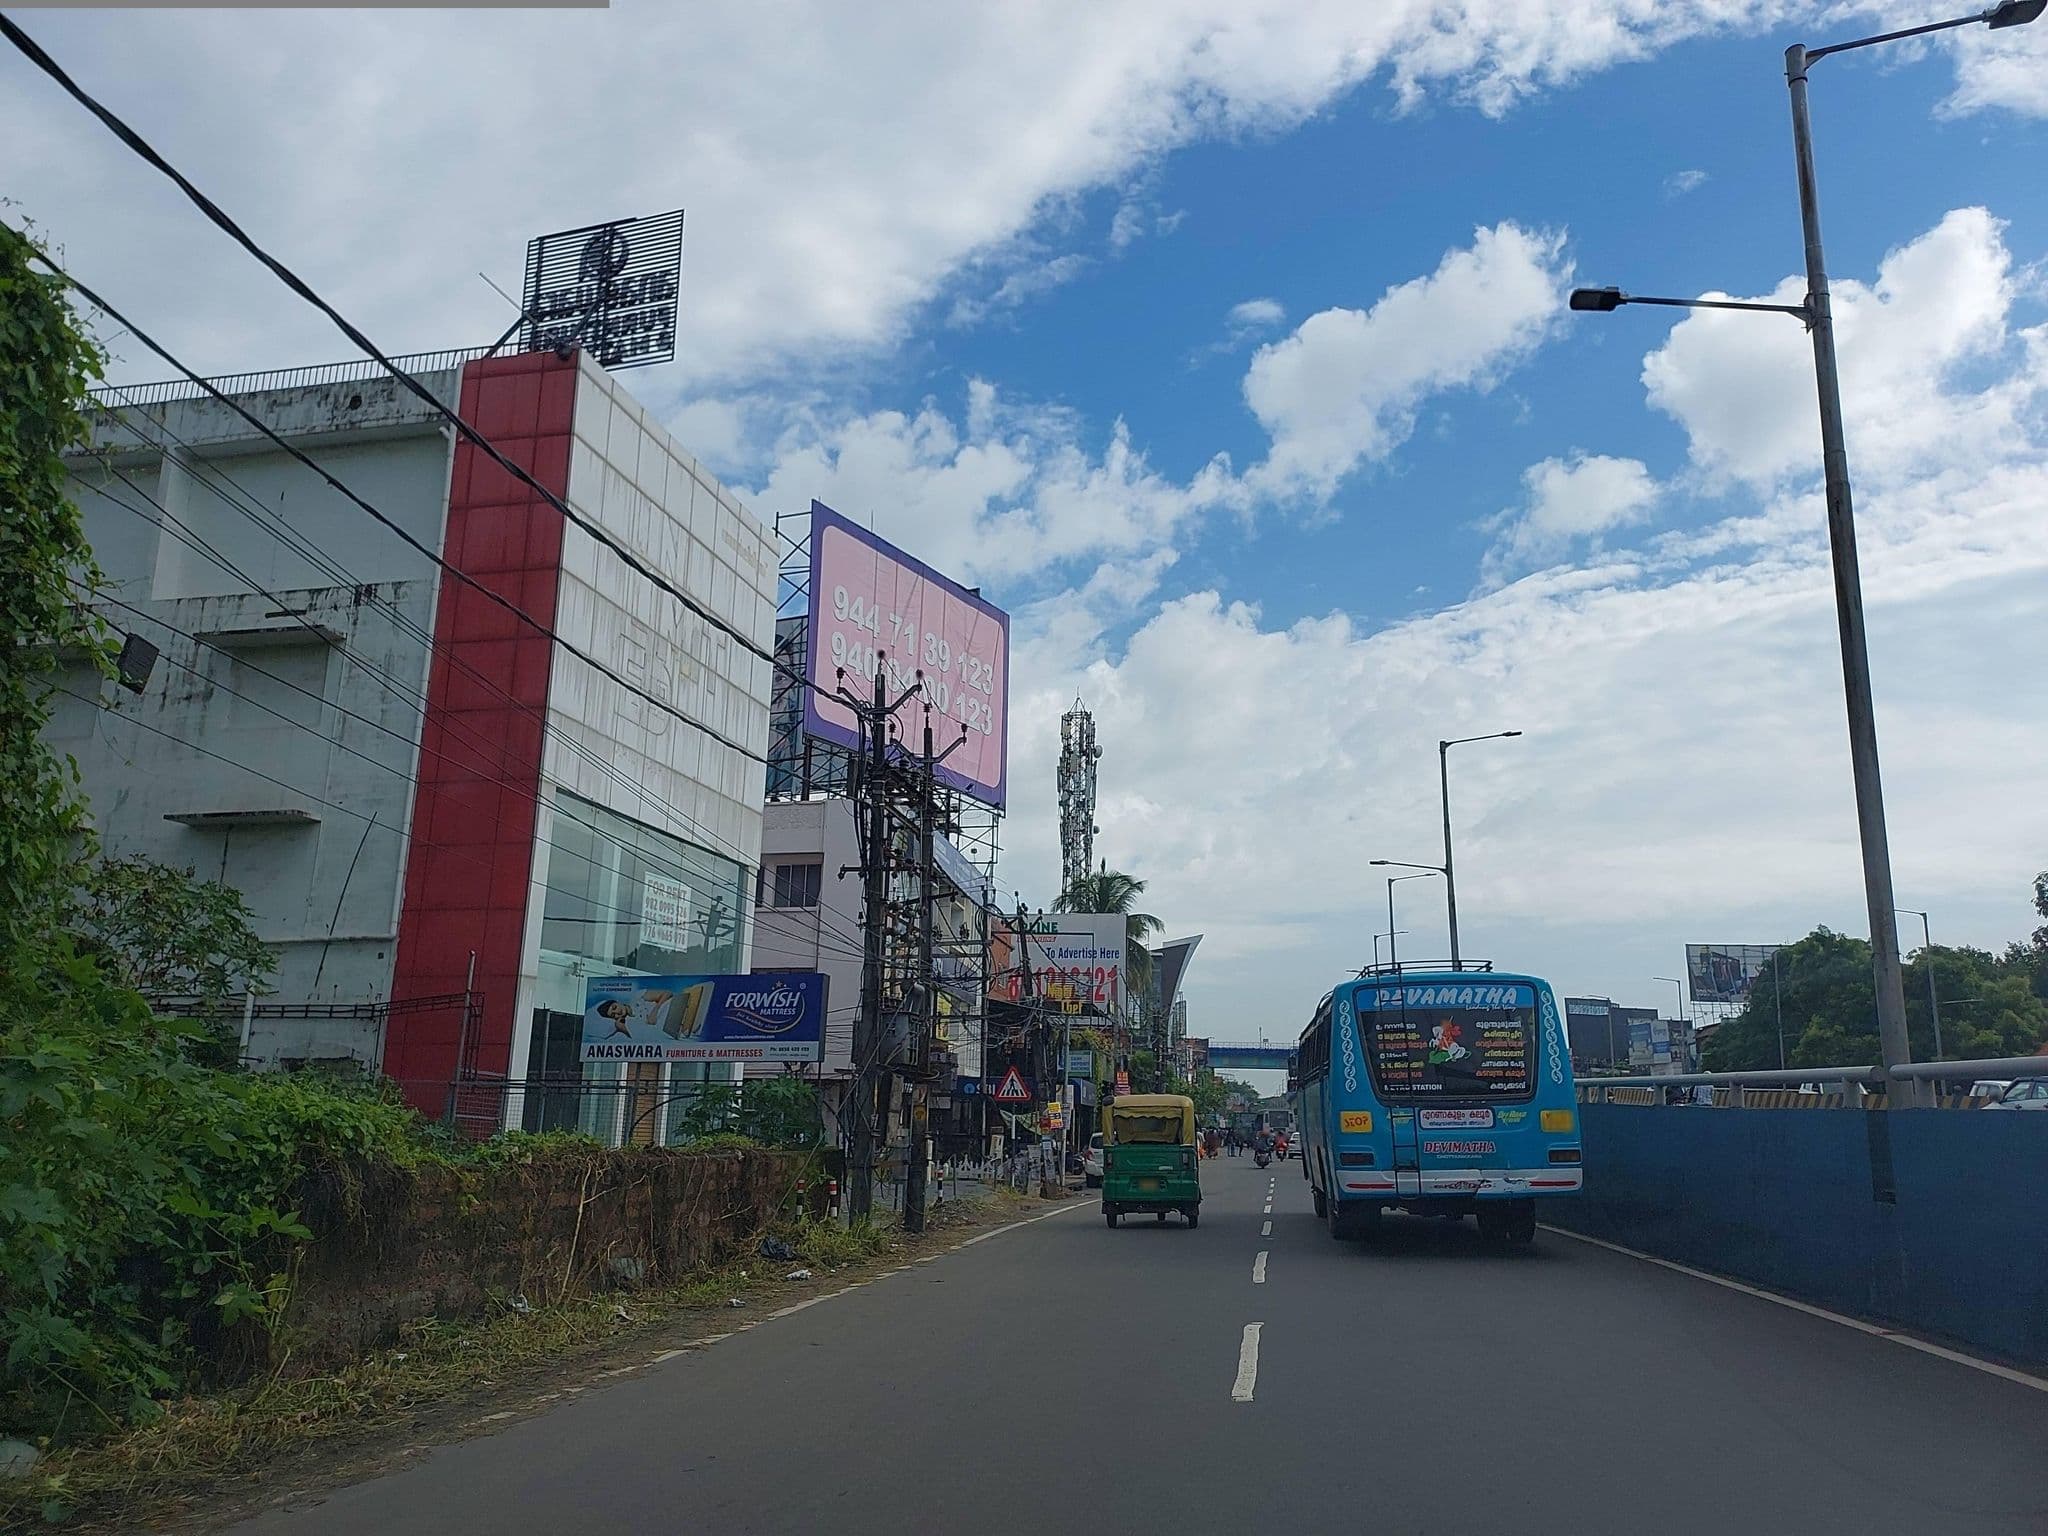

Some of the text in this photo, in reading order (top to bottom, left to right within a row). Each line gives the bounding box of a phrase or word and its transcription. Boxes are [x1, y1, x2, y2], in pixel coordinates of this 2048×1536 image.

[833, 585, 993, 696] 944 71 39 123
[831, 631, 877, 682] 940
[956, 692, 992, 736] 123
[1046, 946, 1120, 959] To Advertise Here
[725, 990, 801, 1010] FORWISH
[1373, 987, 1517, 1007] DEVAMATHA
[759, 1007, 797, 1016] MATTRESS
[587, 1044, 662, 1058] ANASWARA
[665, 1048, 707, 1058] FURNITURE
[715, 1047, 763, 1058] MATTRESSES
[1424, 1141, 1497, 1154] DEVIMATHA
